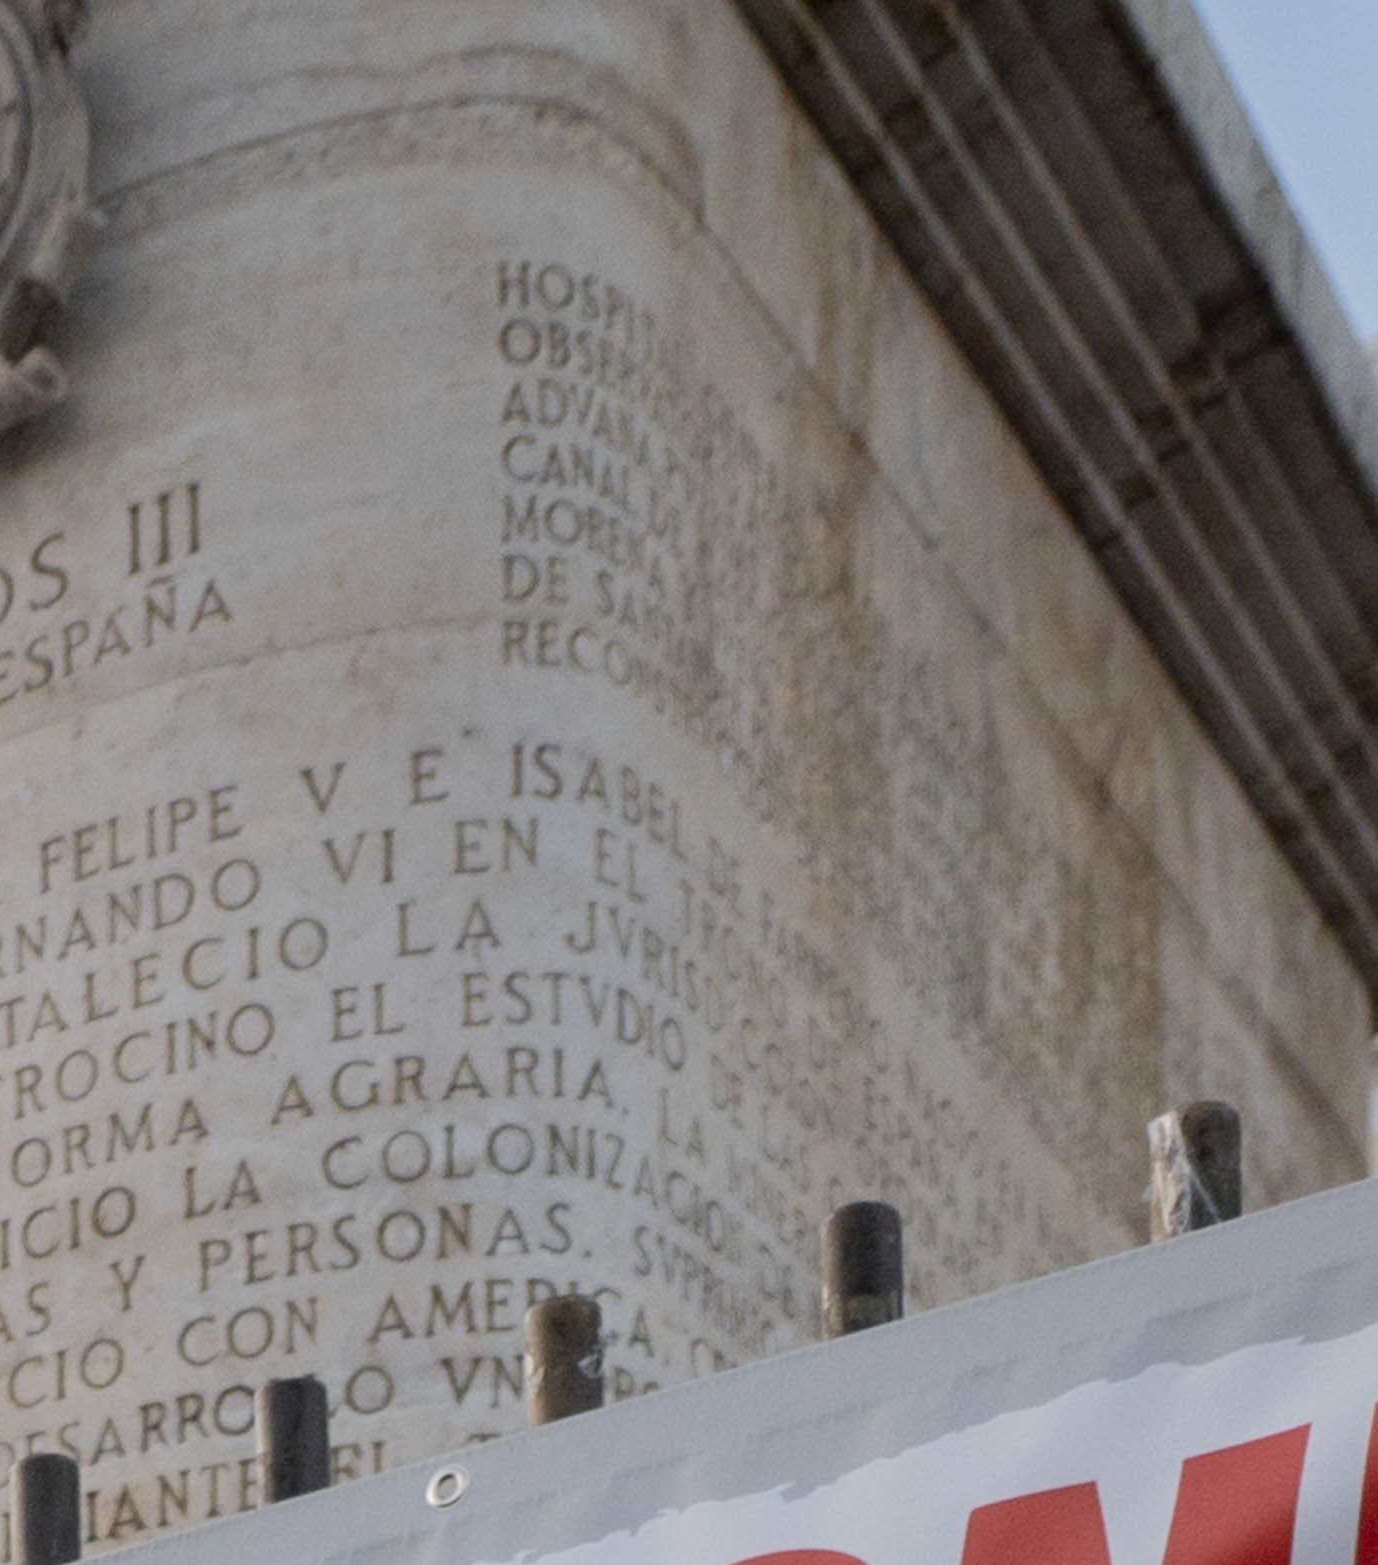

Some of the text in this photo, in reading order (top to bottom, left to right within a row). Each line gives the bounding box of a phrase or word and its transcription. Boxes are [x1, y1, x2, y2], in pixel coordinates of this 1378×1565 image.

[126, 483, 202, 577] III
[502, 553, 569, 602] DE
[38, 785, 243, 894] FELIPE
[300, 762, 346, 815] V
[409, 748, 450, 807] E
[509, 743, 687, 864] ISABEL
[323, 828, 396, 886] VI
[452, 818, 540, 876] EN
[596, 827, 646, 902] EL
[396, 899, 502, 958] LA
[330, 982, 404, 1042] EL
[460, 972, 686, 1072] ESTVDIO
[270, 1047, 630, 1127] AGRARIA.
[183, 1160, 262, 1220] LA
[110, 1255, 148, 1313] Y
[198, 1202, 594, 1293] PERSONAS.
[176, 1298, 320, 1369] CON
